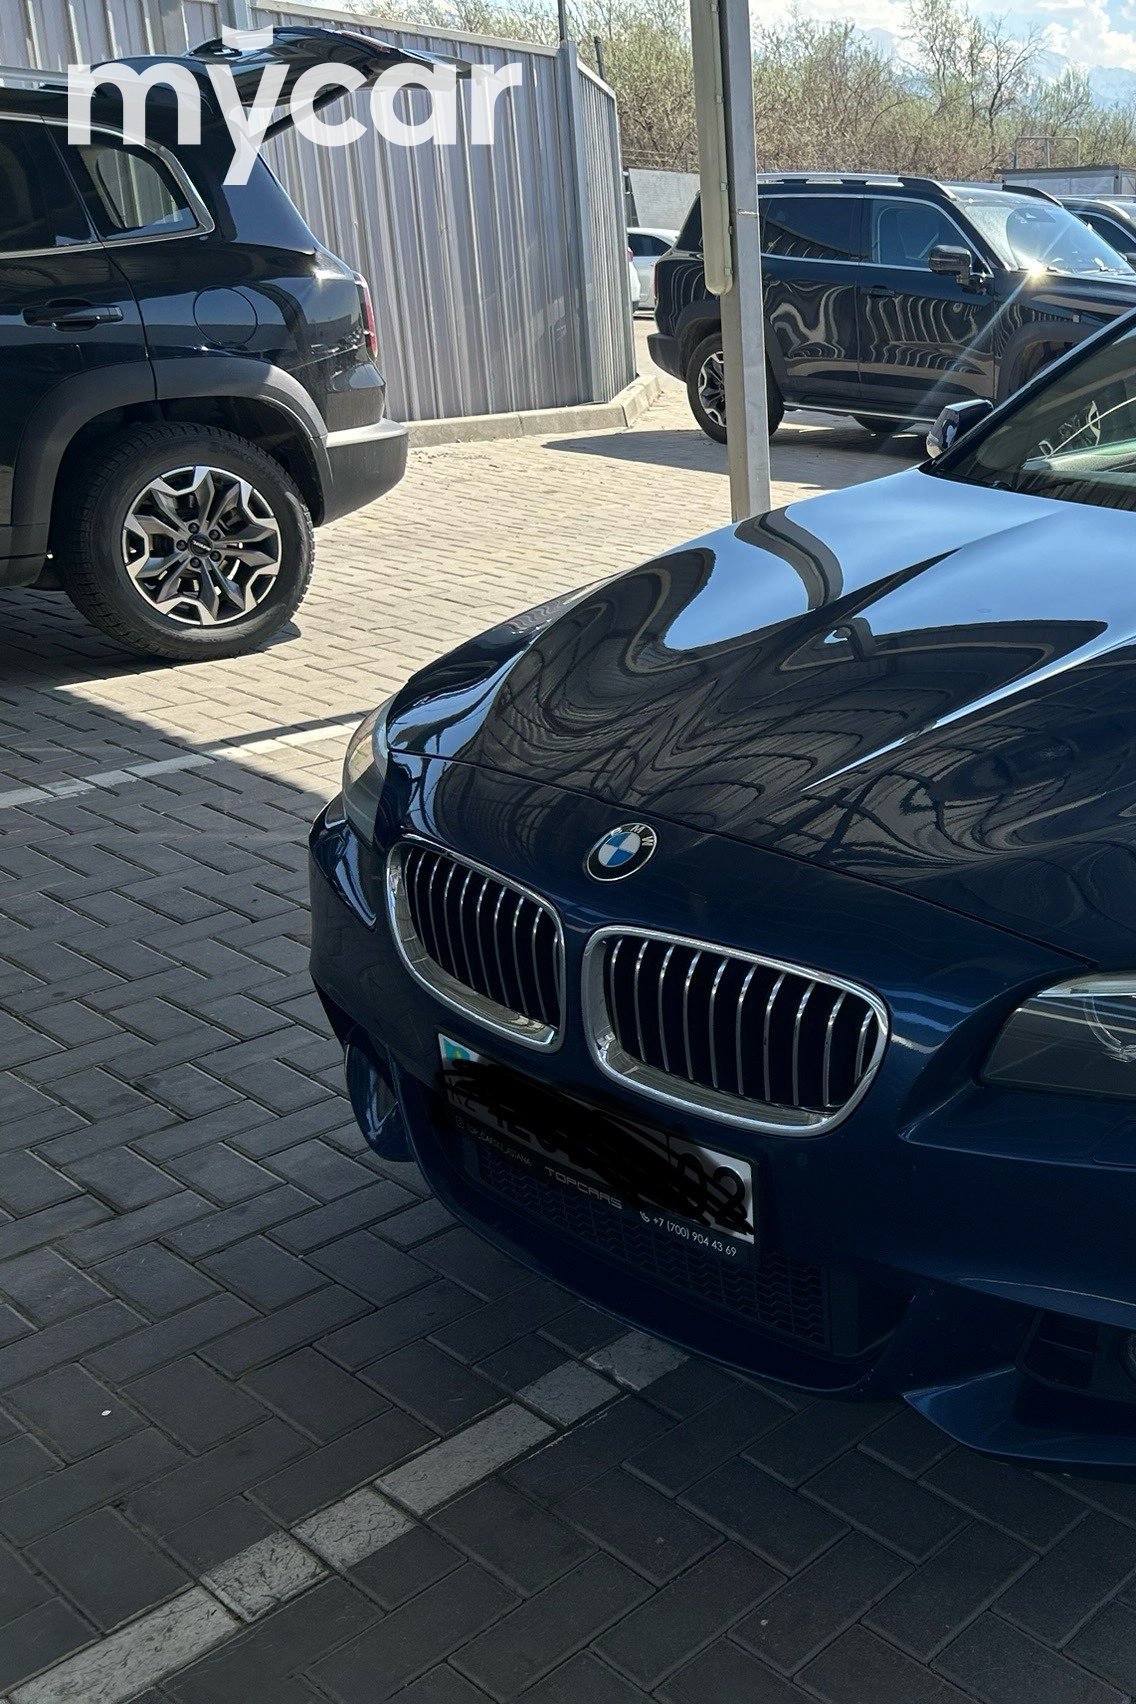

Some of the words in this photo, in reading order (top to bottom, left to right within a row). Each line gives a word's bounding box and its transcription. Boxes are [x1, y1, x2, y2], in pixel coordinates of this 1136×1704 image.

[544, 1166, 623, 1210] TOPCARS
[653, 1216, 665, 1227] +7
[666, 1220, 690, 1240] (700)
[691, 1231, 710, 1247] 904
[711, 1240, 724, 1252] 43
[725, 1245, 738, 1257] 69
